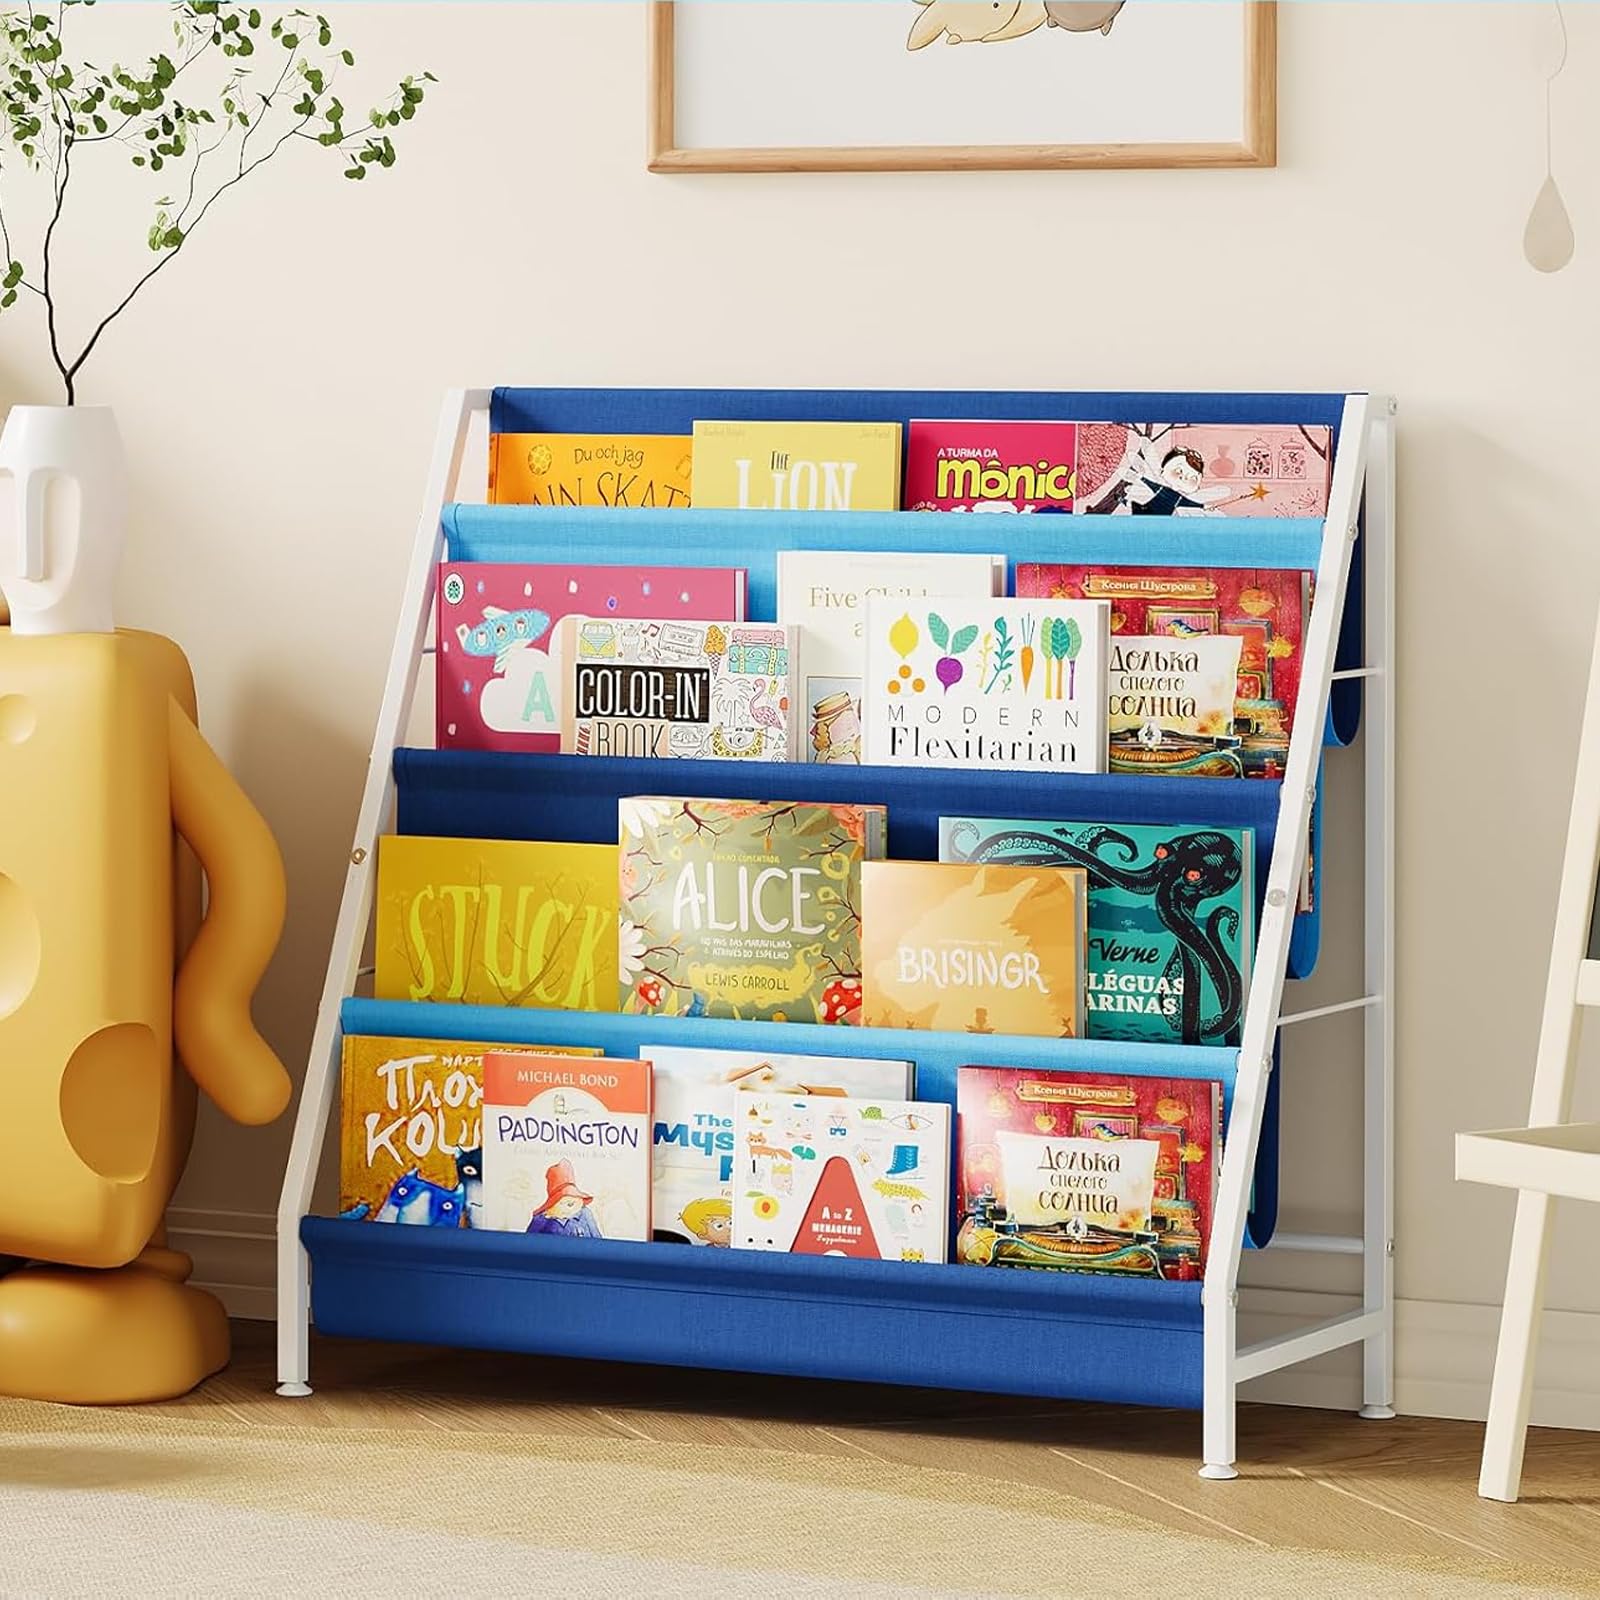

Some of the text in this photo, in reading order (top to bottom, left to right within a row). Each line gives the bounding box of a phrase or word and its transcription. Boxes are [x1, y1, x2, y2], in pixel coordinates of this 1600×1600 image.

[574, 445, 644, 469] Du och jag
[771, 451, 790, 470] THE
[937, 448, 999, 458] A TURMA DA
[809, 586, 858, 609] Five
[1101, 580, 1197, 592] Ксения Шустрова
[1110, 645, 1199, 674] Долька
[1120, 675, 1184, 691] спелого
[522, 671, 555, 722] A
[1109, 694, 1198, 720] солнца
[888, 704, 1079, 728] MODERN
[597, 722, 664, 758] BOOK
[888, 727, 1077, 762] Flexitarian
[673, 861, 825, 935] ALICE
[408, 884, 612, 1011] STUCK
[1089, 938, 1160, 964] Verne
[706, 973, 789, 991] LEWIS CARROLL
[899, 946, 1049, 994] BRISINGR
[1088, 968, 1184, 995] LÉGUAS
[517, 1070, 618, 1087] MICHAEL BOND
[693, 1113, 733, 1127] The
[1037, 1145, 1120, 1172] Долька
[1050, 1174, 1107, 1190] спелого
[822, 1206, 831, 1220] A
[844, 1208, 853, 1221] Z
[1039, 1191, 1118, 1216] солнца
[811, 1223, 862, 1235] MENAGERIE
